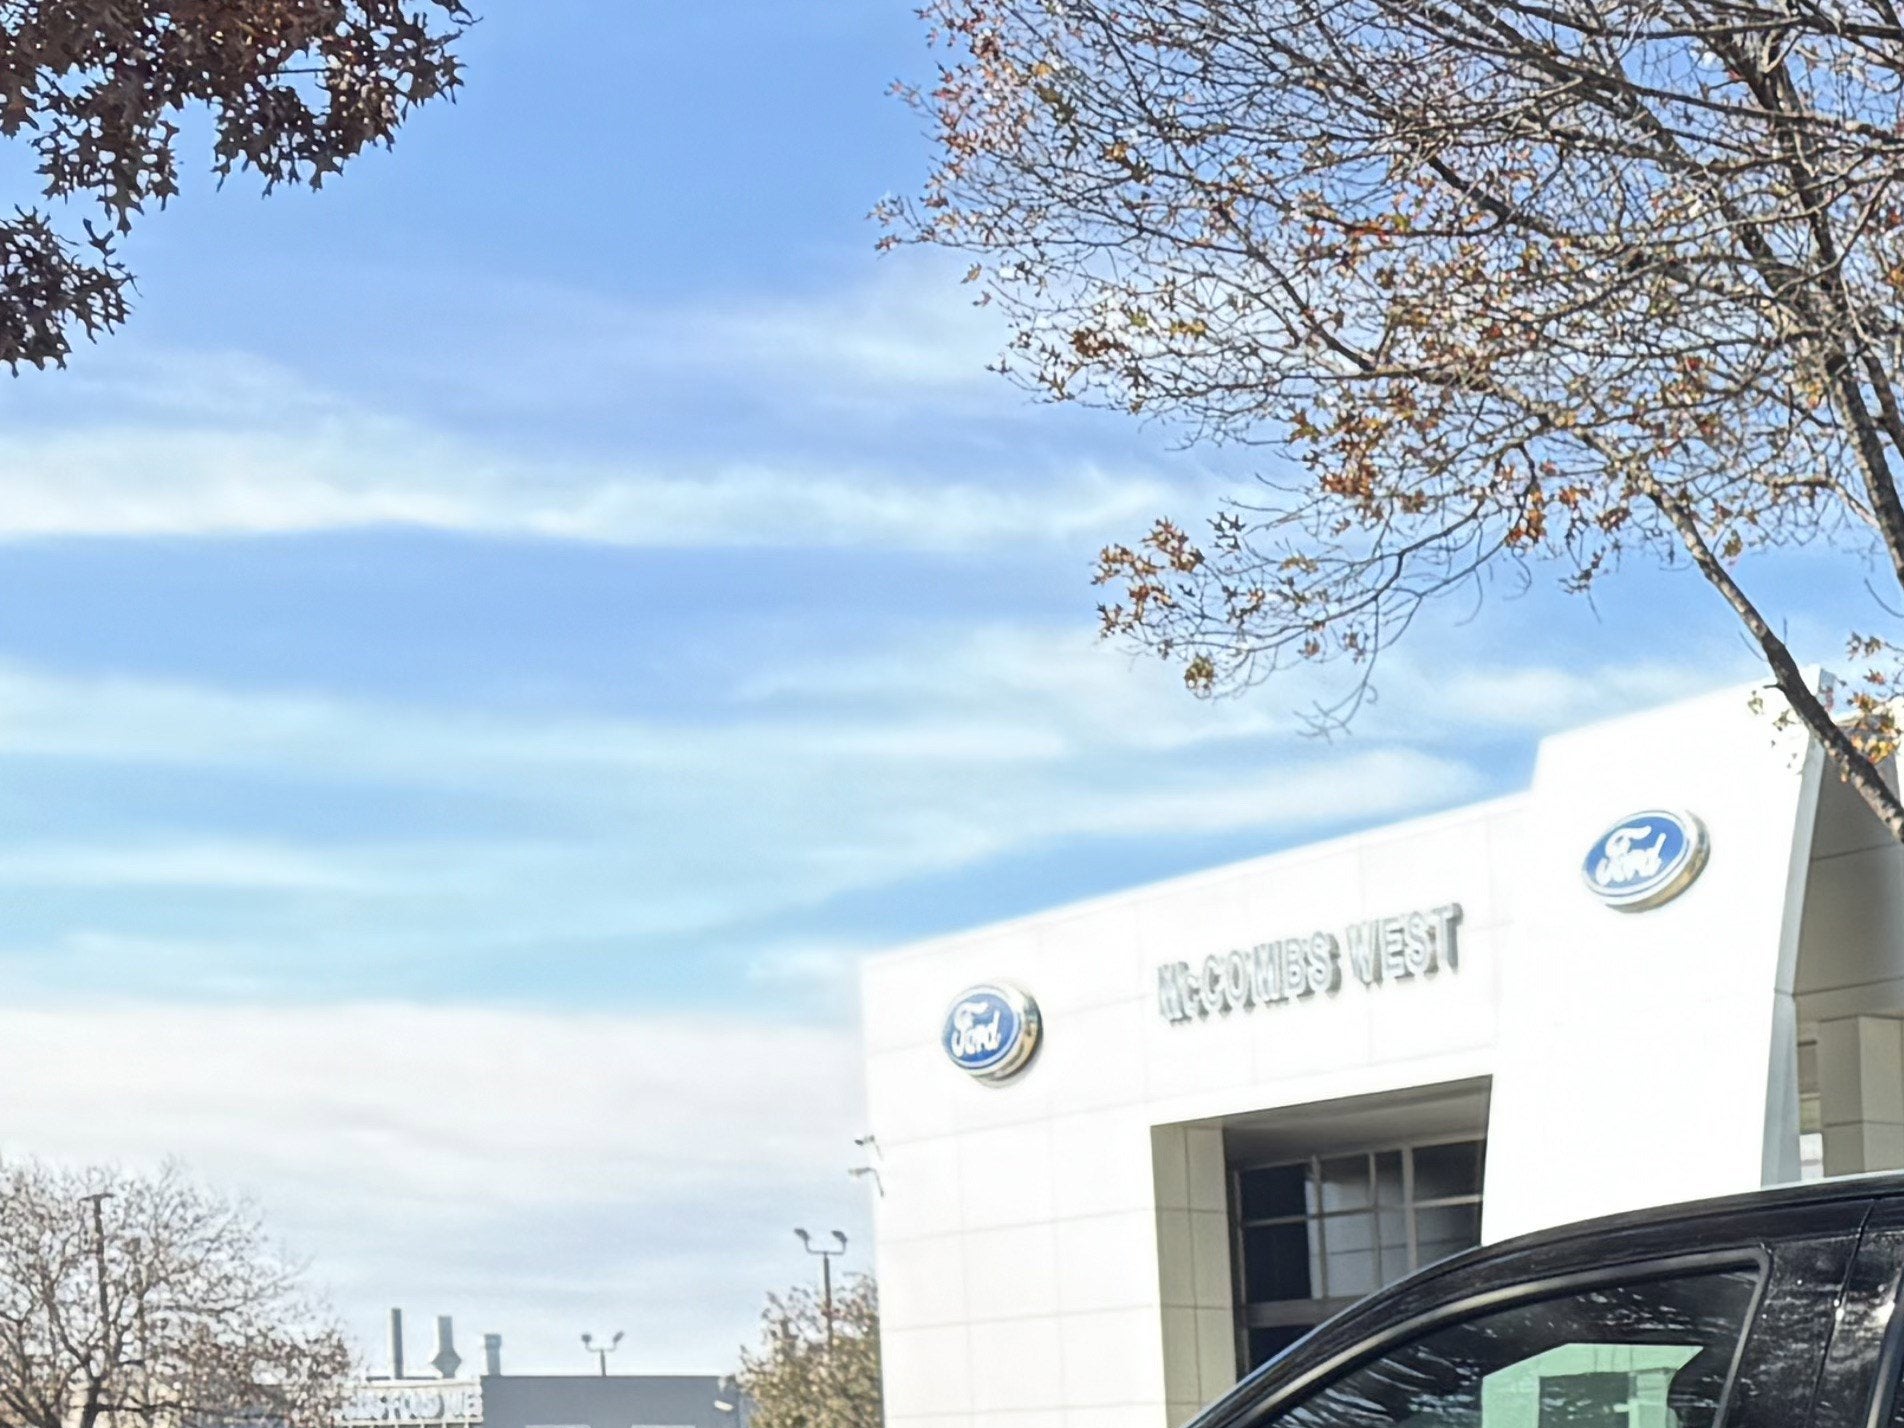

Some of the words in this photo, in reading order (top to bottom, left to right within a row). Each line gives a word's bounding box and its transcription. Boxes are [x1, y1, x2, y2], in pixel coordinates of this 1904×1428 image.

[1595, 825, 1667, 885] Ford
[1346, 902, 1463, 988] WEST
[950, 1001, 1002, 1058] Ford
